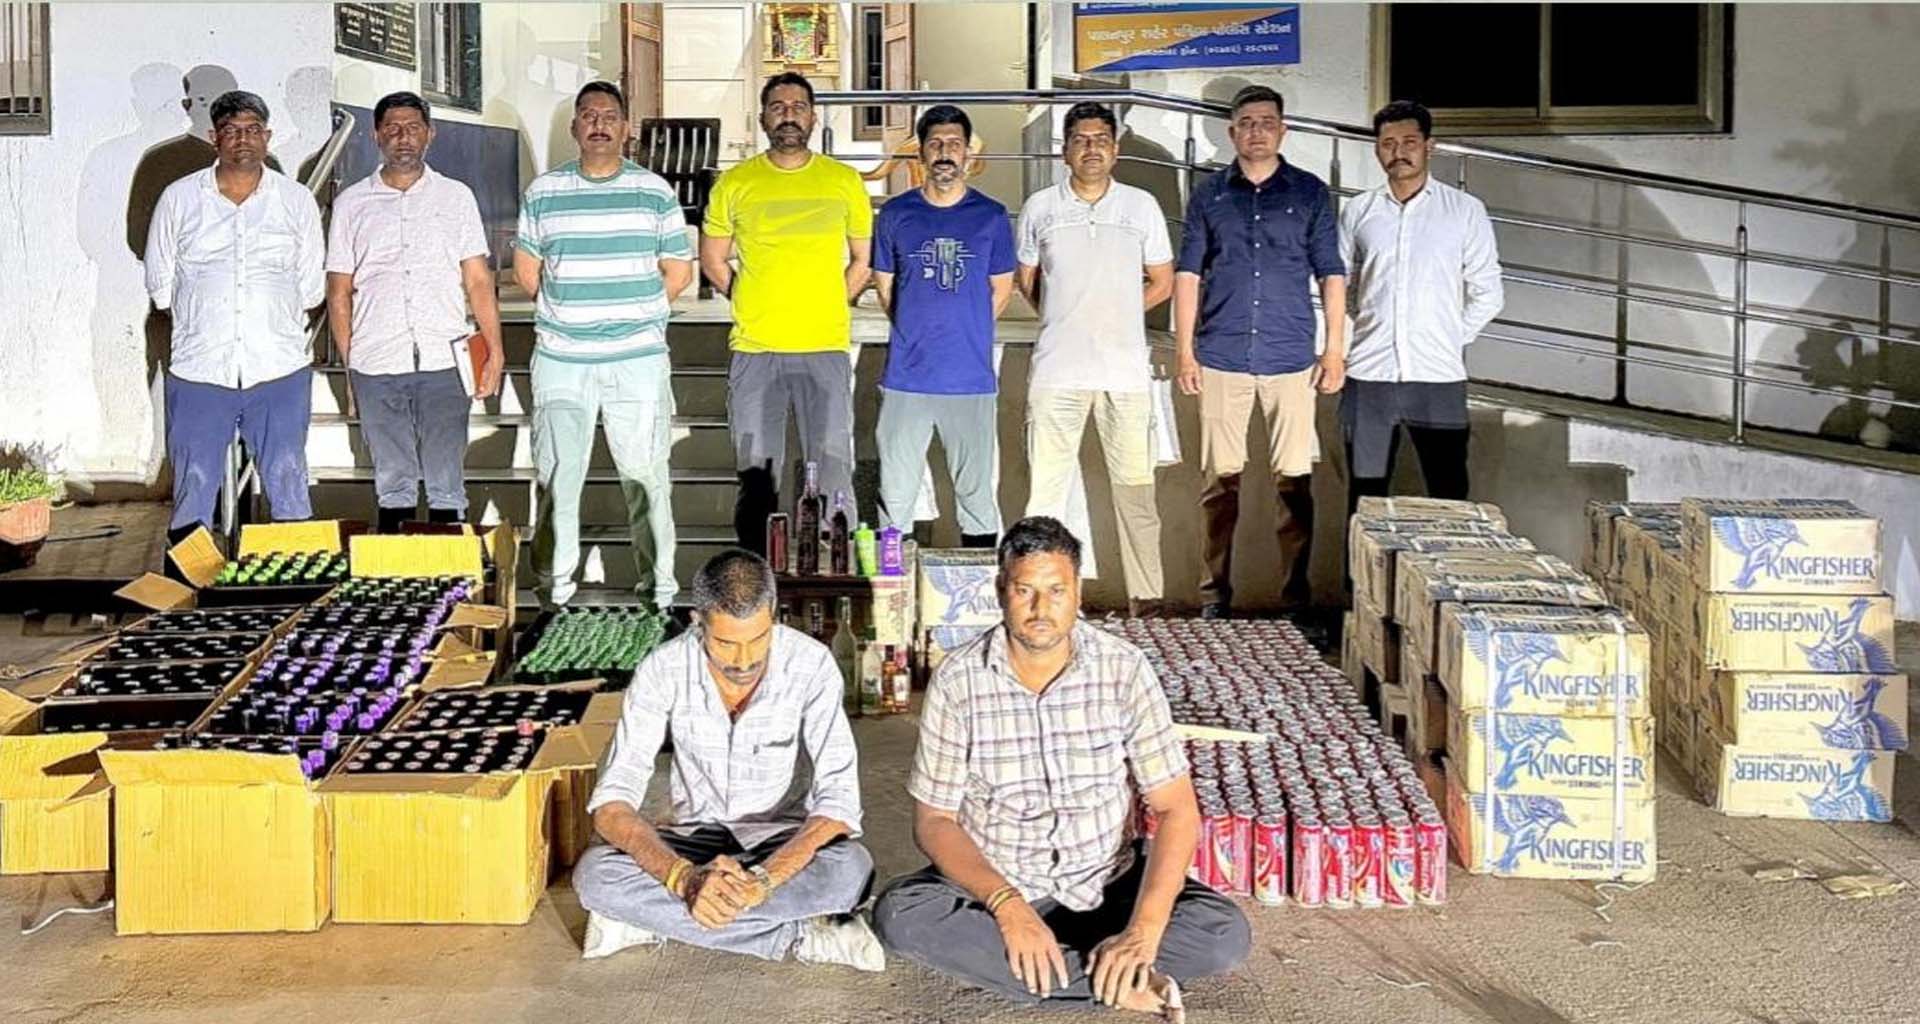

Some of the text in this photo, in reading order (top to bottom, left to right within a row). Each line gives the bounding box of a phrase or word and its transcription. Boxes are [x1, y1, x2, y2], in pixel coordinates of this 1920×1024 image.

[1766, 552, 1876, 580] KINGFISHER
[1730, 607, 1839, 635] KINGFISHER
[1523, 670, 1639, 699] KINGFISHR
[1745, 688, 1853, 714] KINGFISHER
[1528, 749, 1646, 781] KINGFISHER
[1734, 758, 1842, 786] KINGFISHER
